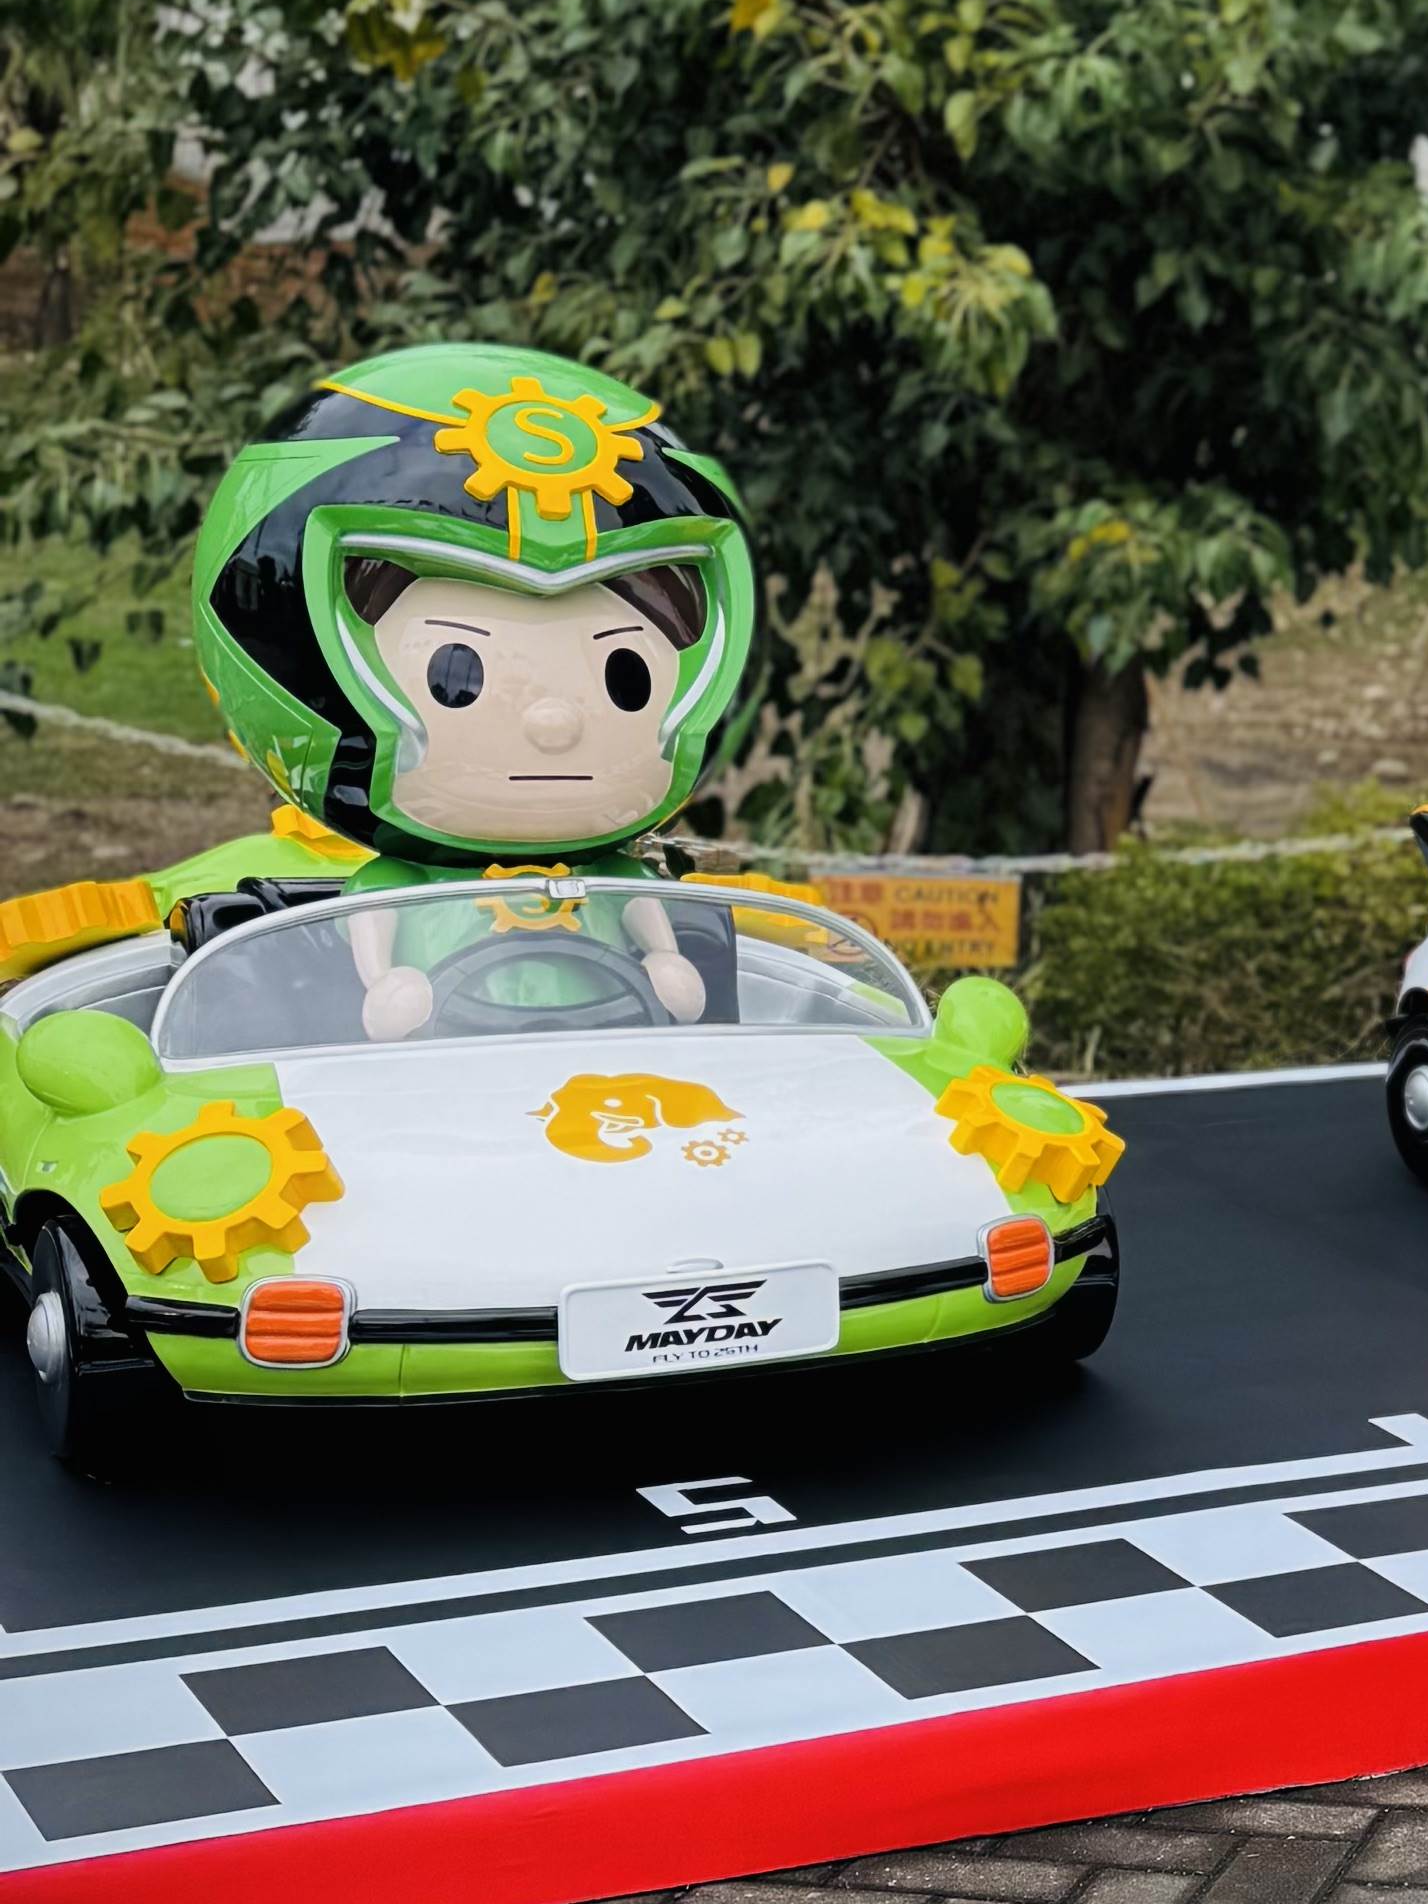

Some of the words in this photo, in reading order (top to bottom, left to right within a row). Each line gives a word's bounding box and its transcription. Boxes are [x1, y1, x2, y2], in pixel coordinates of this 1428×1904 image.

[514, 408, 574, 465] S
[893, 885, 999, 905] CAUTION
[624, 1318, 783, 1352] MAYDAY
[653, 1351, 684, 1364] FLY
[689, 1348, 711, 1360] TO
[714, 1344, 759, 1357] 25TH
[636, 1476, 797, 1534] 5
